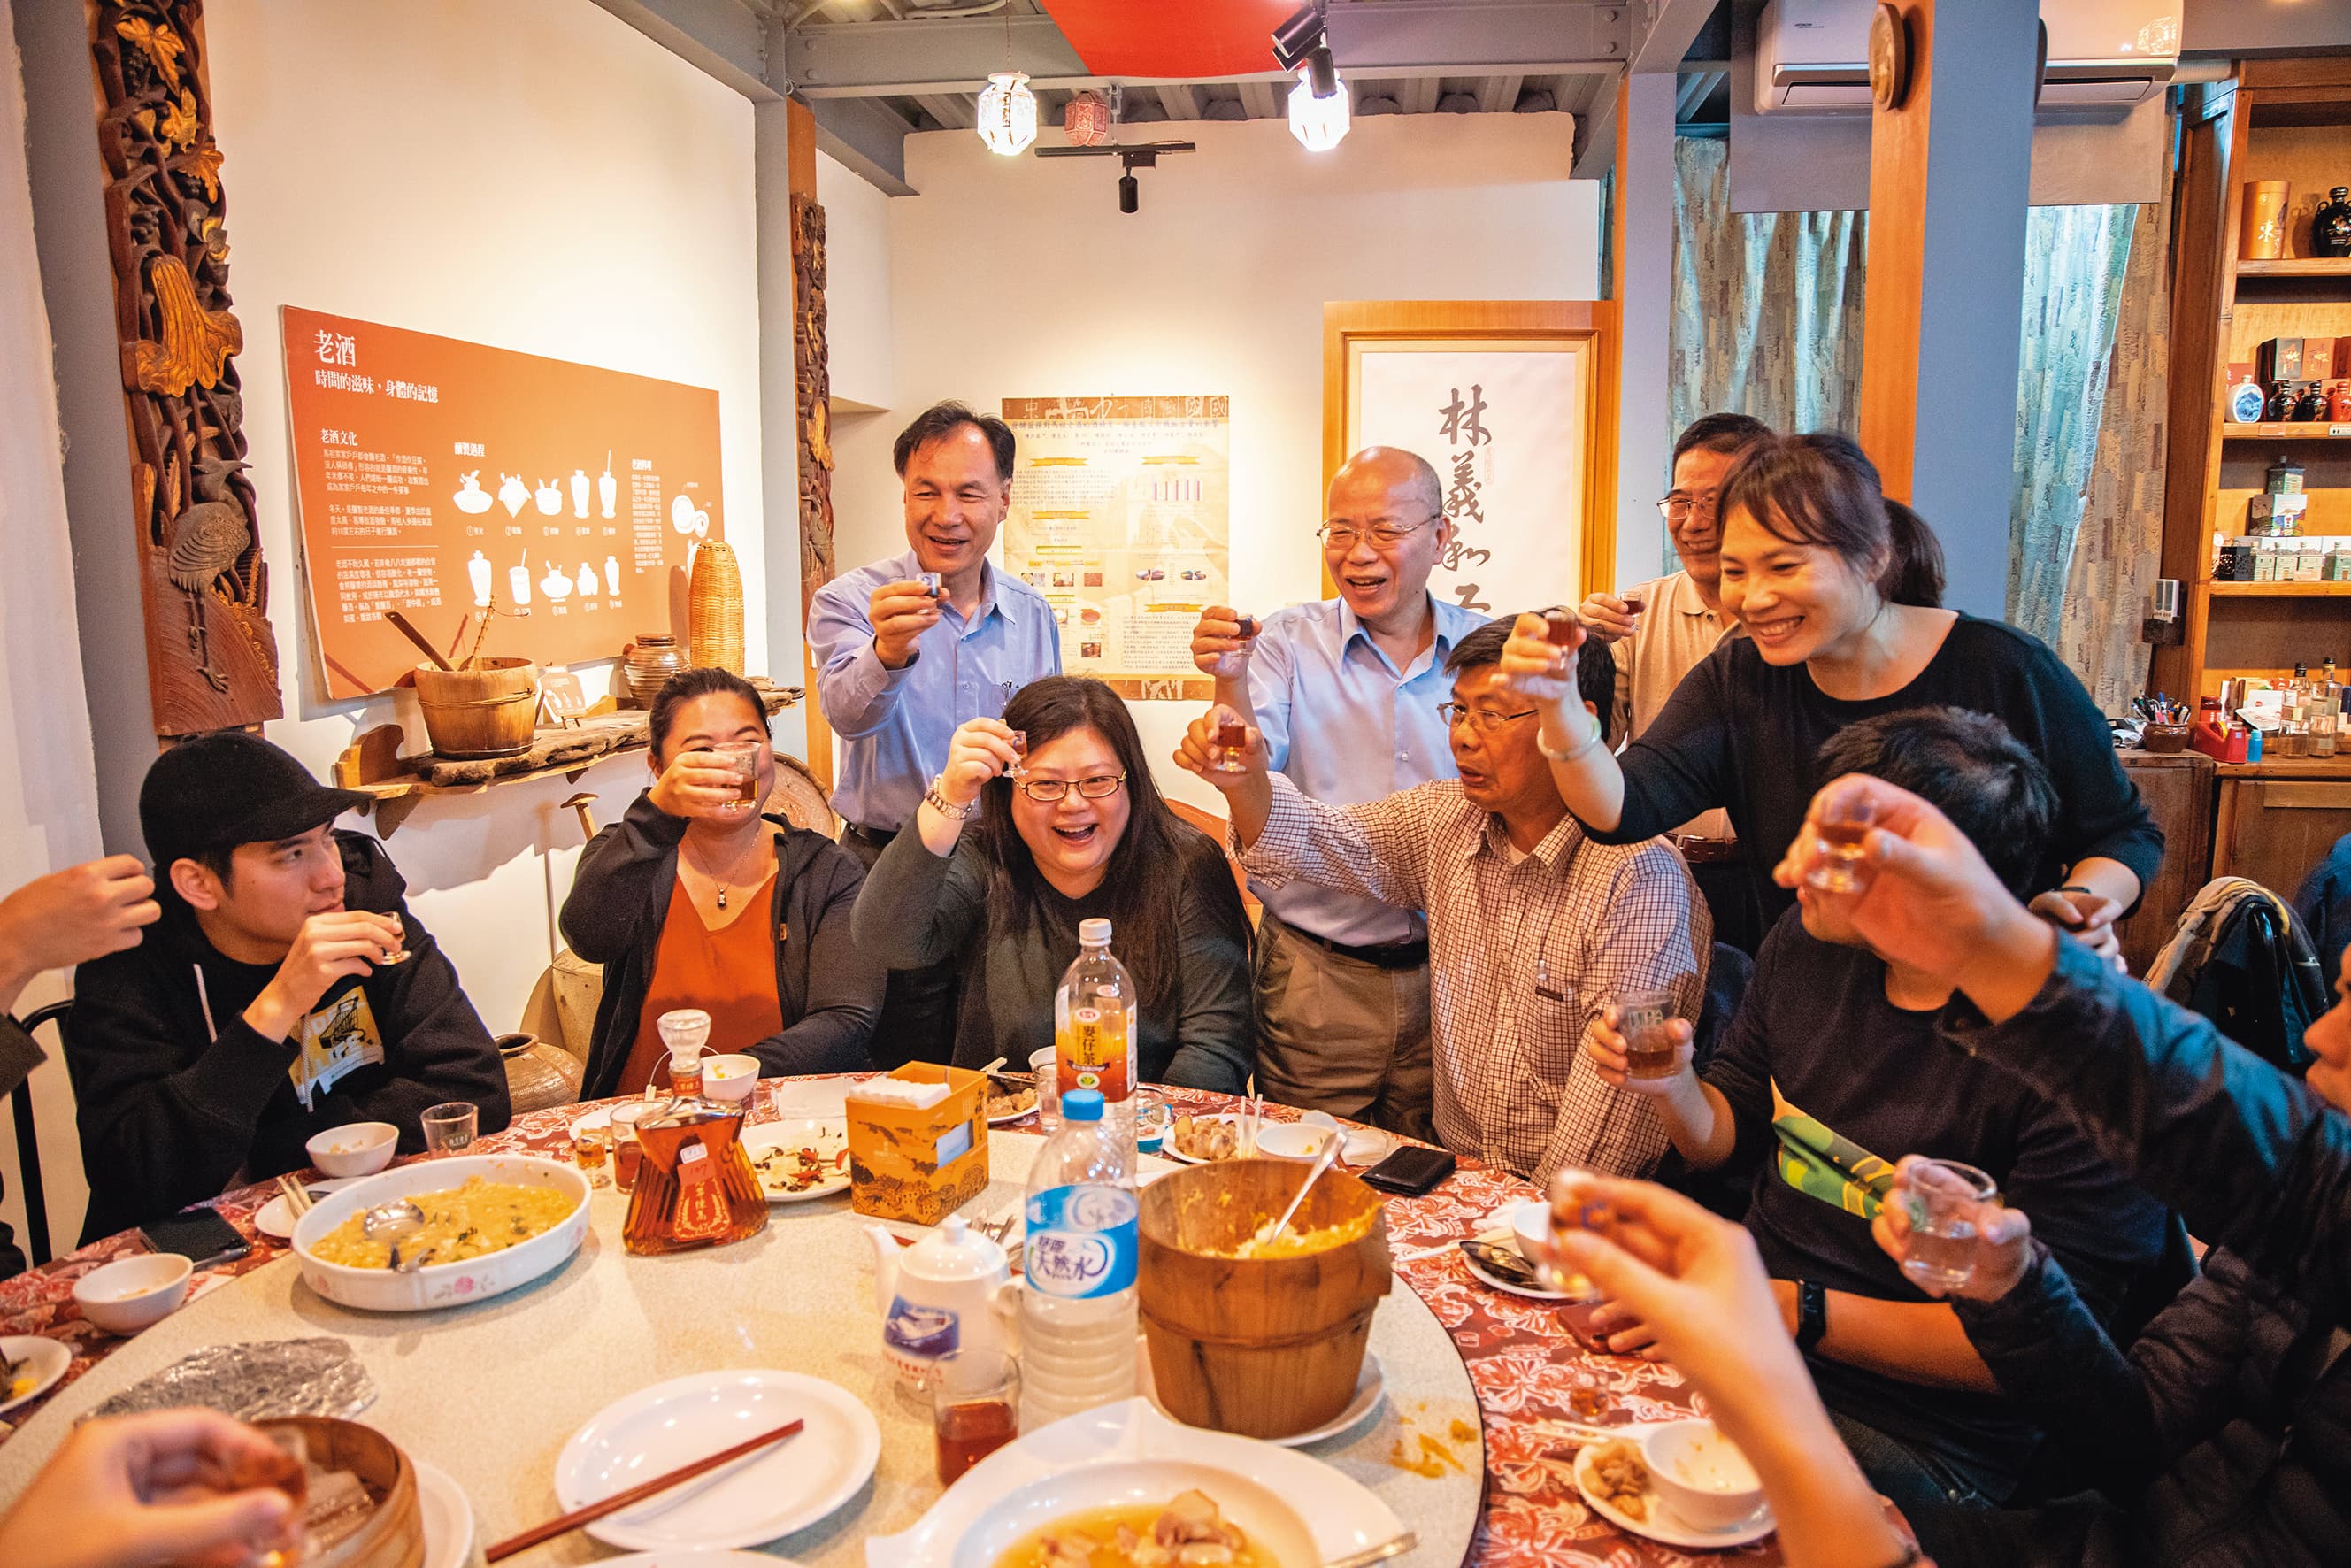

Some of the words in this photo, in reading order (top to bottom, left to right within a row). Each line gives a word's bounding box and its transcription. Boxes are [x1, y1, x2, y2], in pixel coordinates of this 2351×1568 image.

[313, 329, 357, 367] 老酒
[314, 369, 439, 404] 時間的滋味，身體的記憶
[320, 428, 358, 446] 老酒文化
[1082, 1026, 1096, 1066] 麥仔茶
[1036, 1250, 1094, 1281] 天然水
